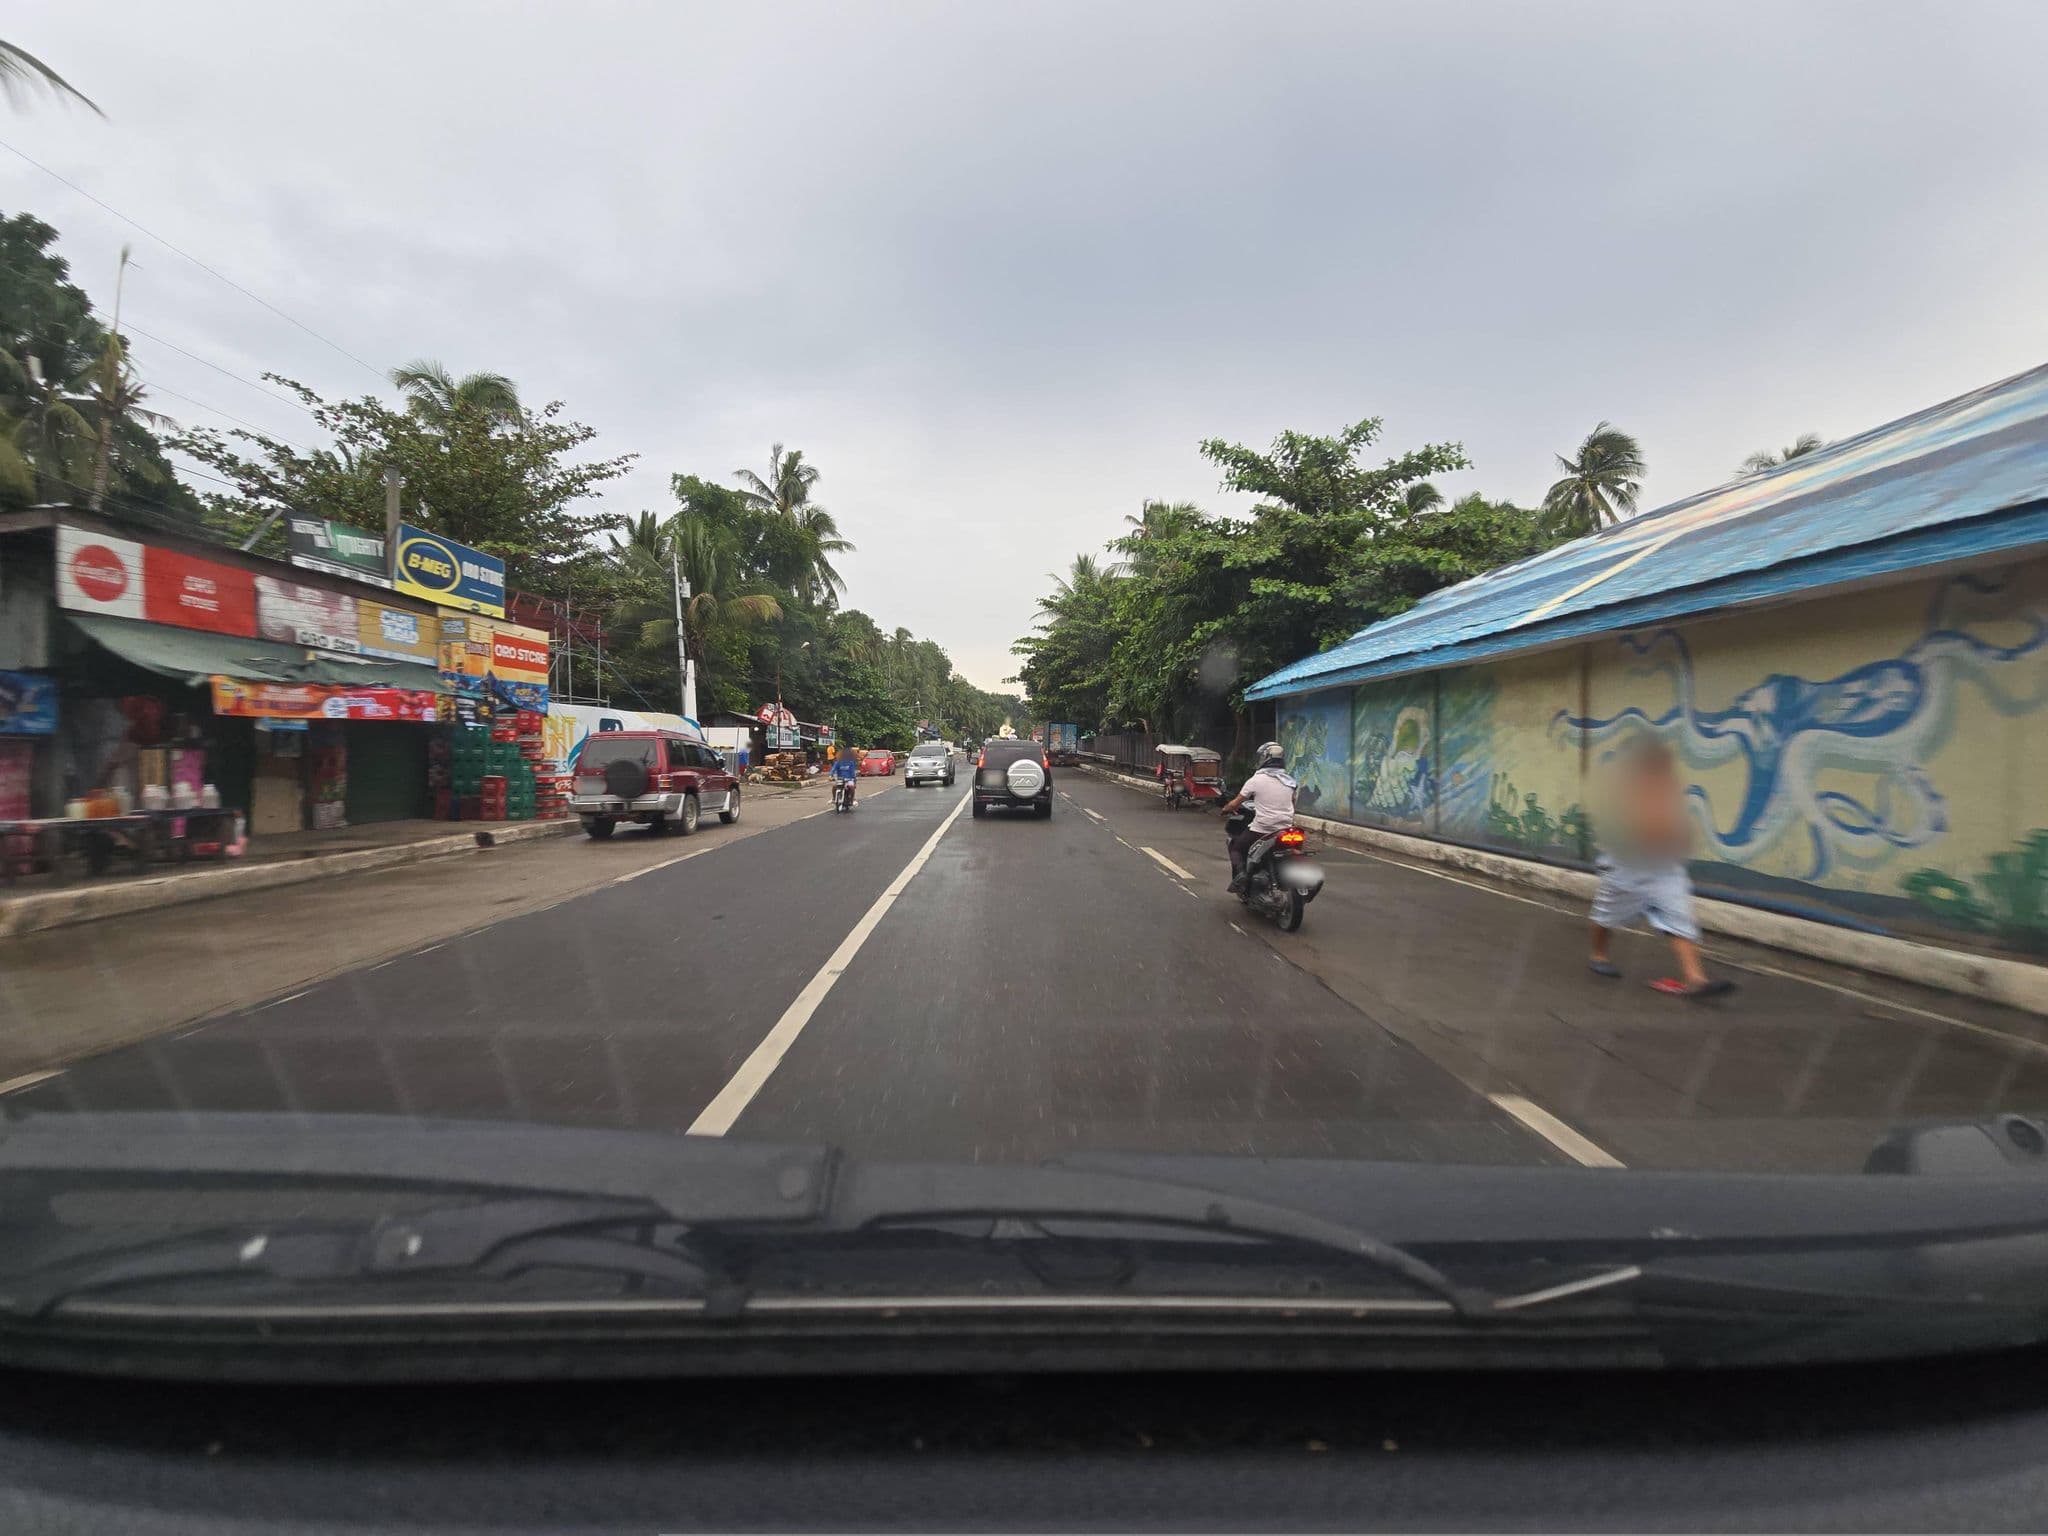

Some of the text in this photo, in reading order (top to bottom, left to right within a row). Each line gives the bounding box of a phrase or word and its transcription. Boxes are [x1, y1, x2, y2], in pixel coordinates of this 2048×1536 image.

[407, 552, 452, 579] B-MEG
[494, 643, 517, 660] ORO
[517, 647, 548, 665] STORE
